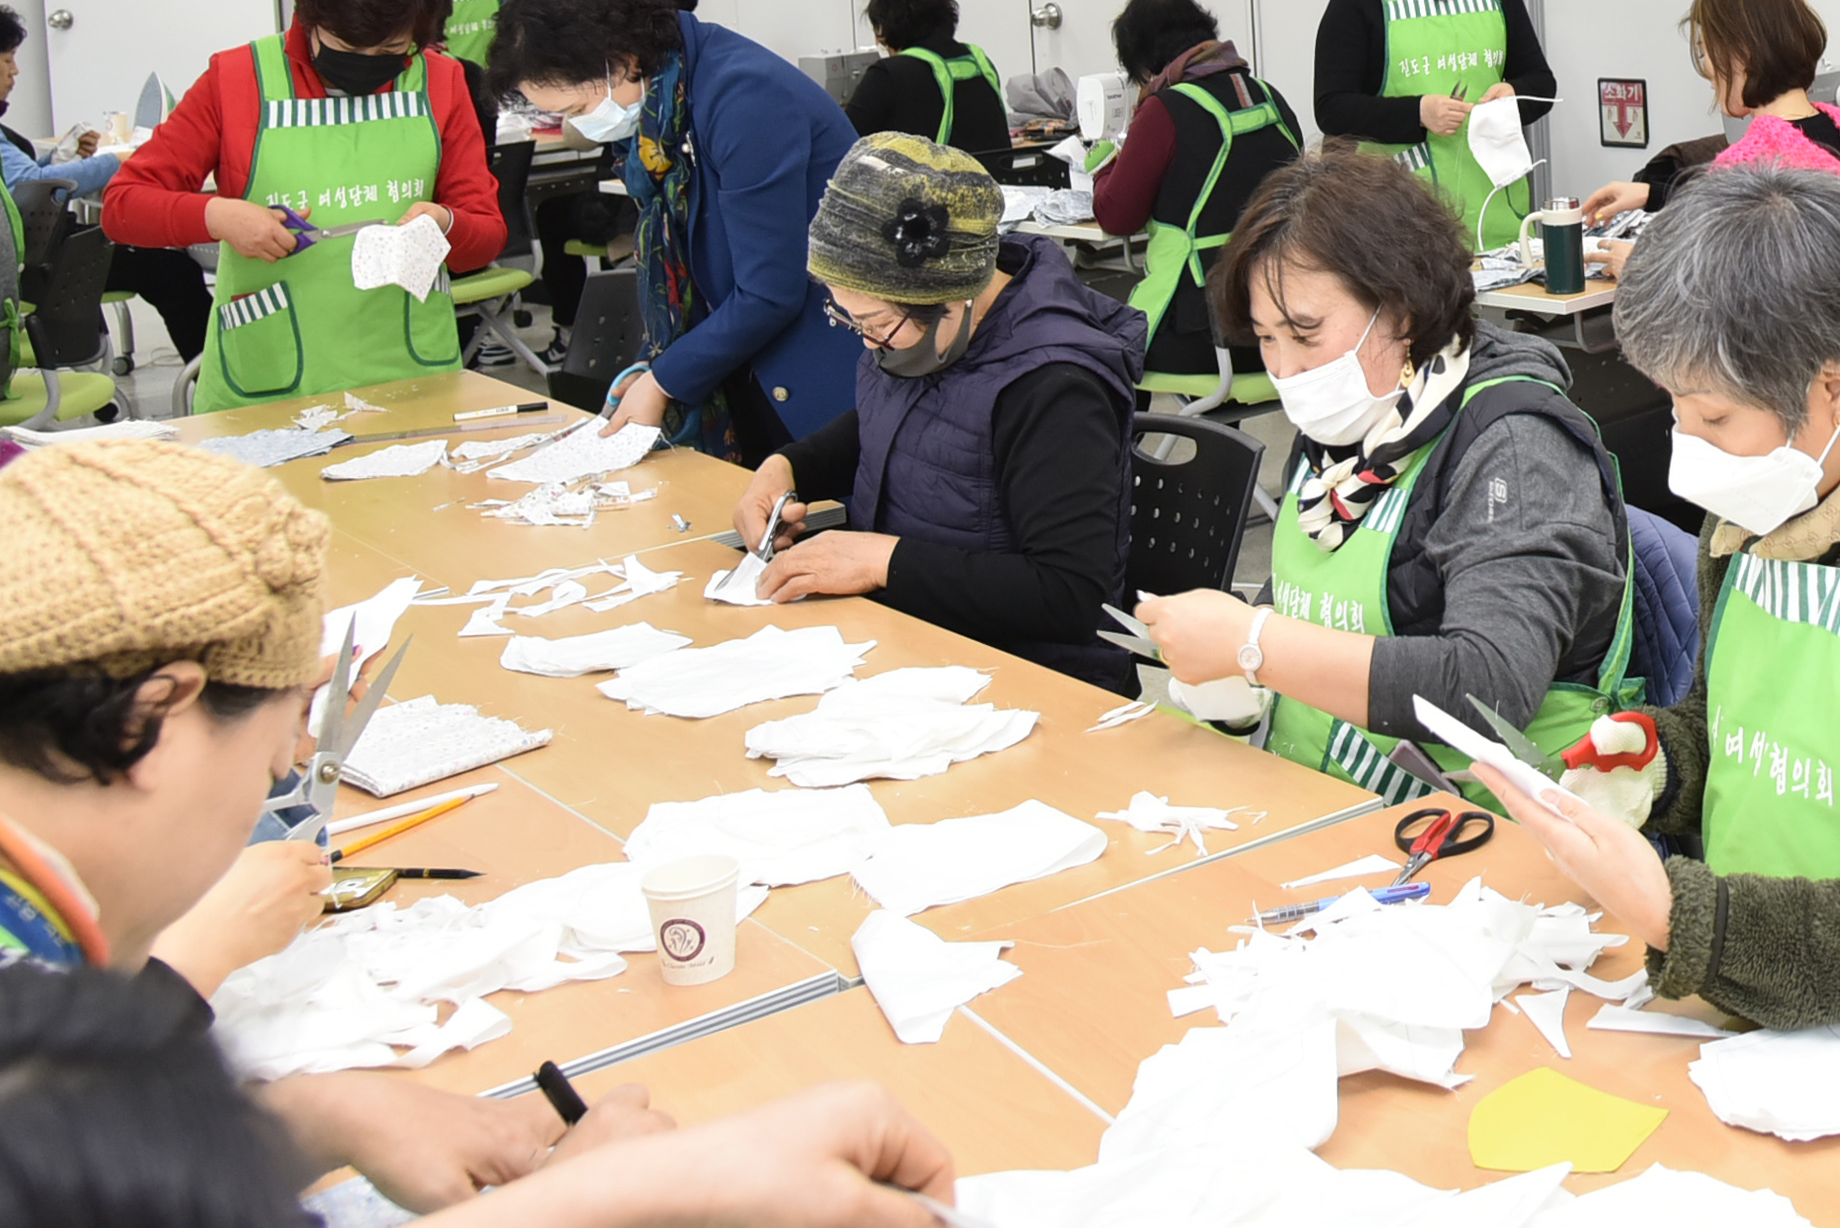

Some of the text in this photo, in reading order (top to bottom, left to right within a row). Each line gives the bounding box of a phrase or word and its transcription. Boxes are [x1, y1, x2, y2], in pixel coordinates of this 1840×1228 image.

[1399, 57, 1431, 78] 진도군
[1604, 83, 1640, 101] 소화기
[318, 183, 378, 210] 여성단체
[386, 177, 424, 204] 협의회
[1320, 590, 1365, 635] 협의회
